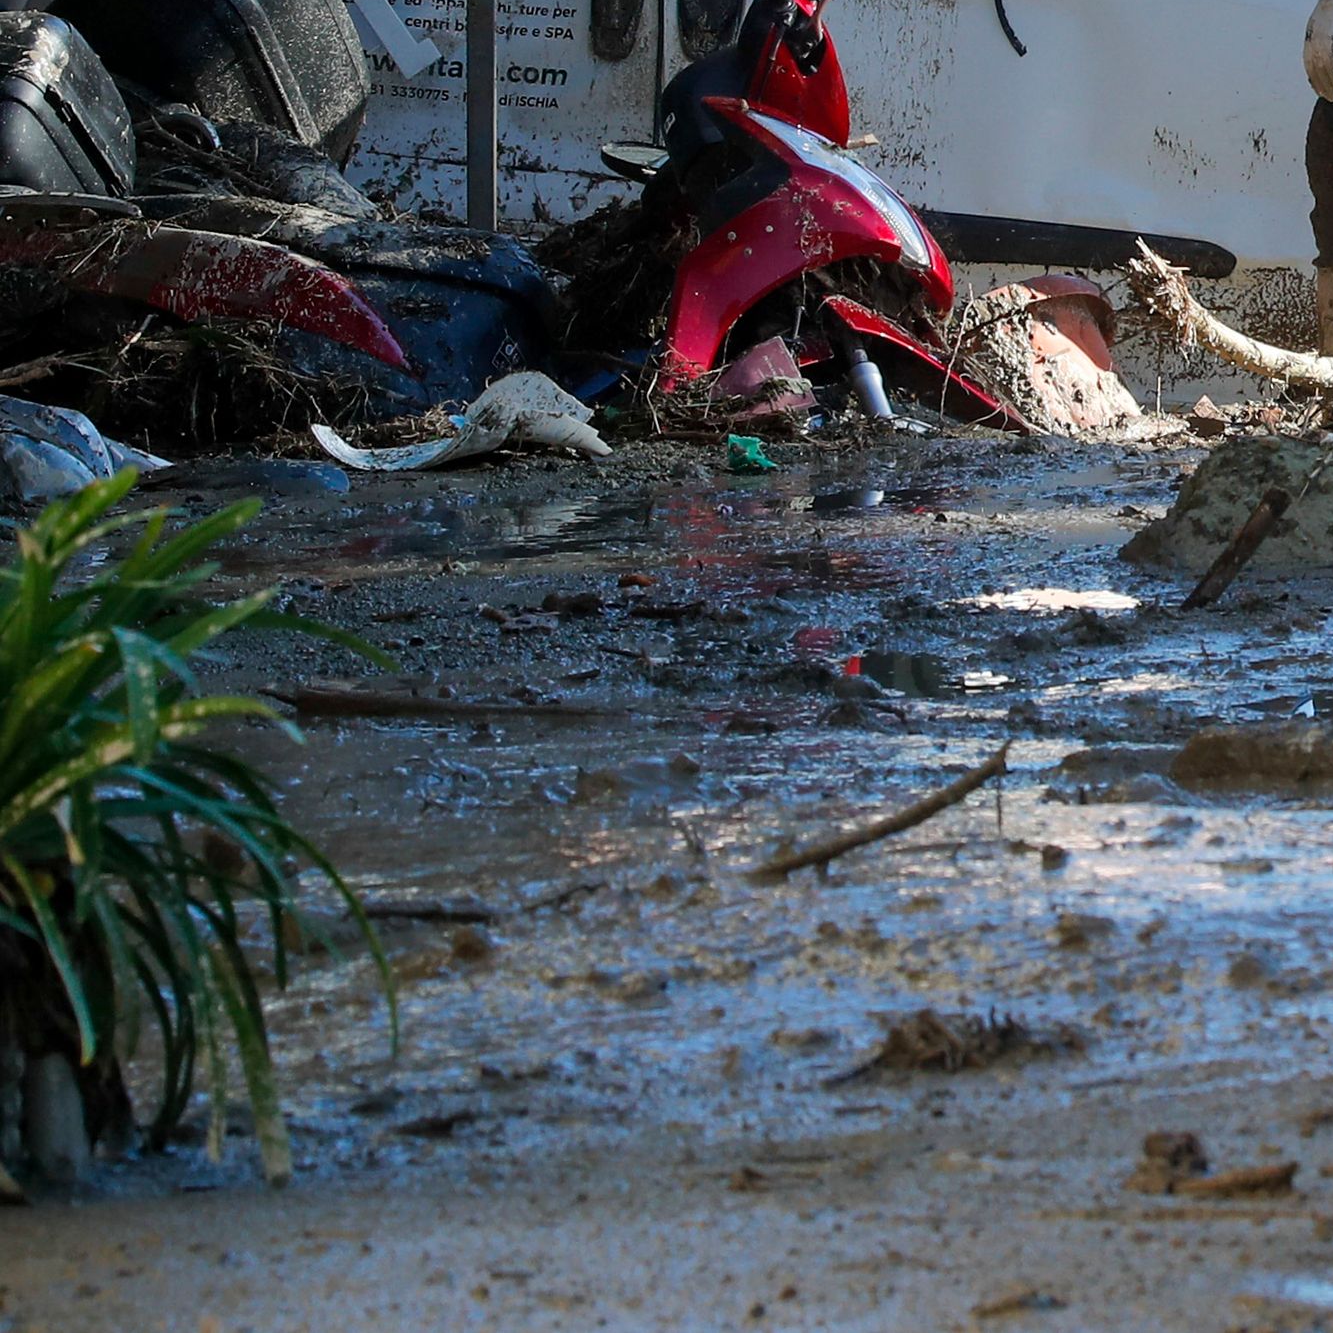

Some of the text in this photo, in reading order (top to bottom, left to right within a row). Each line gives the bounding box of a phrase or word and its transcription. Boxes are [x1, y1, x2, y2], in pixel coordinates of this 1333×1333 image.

[552, 5, 577, 19] per
[405, 17, 450, 31] centri
[545, 27, 574, 40] SPA
[391, 85, 449, 100] 3330775
[499, 96, 511, 107] di
[516, 97, 559, 109] ISCHIA
